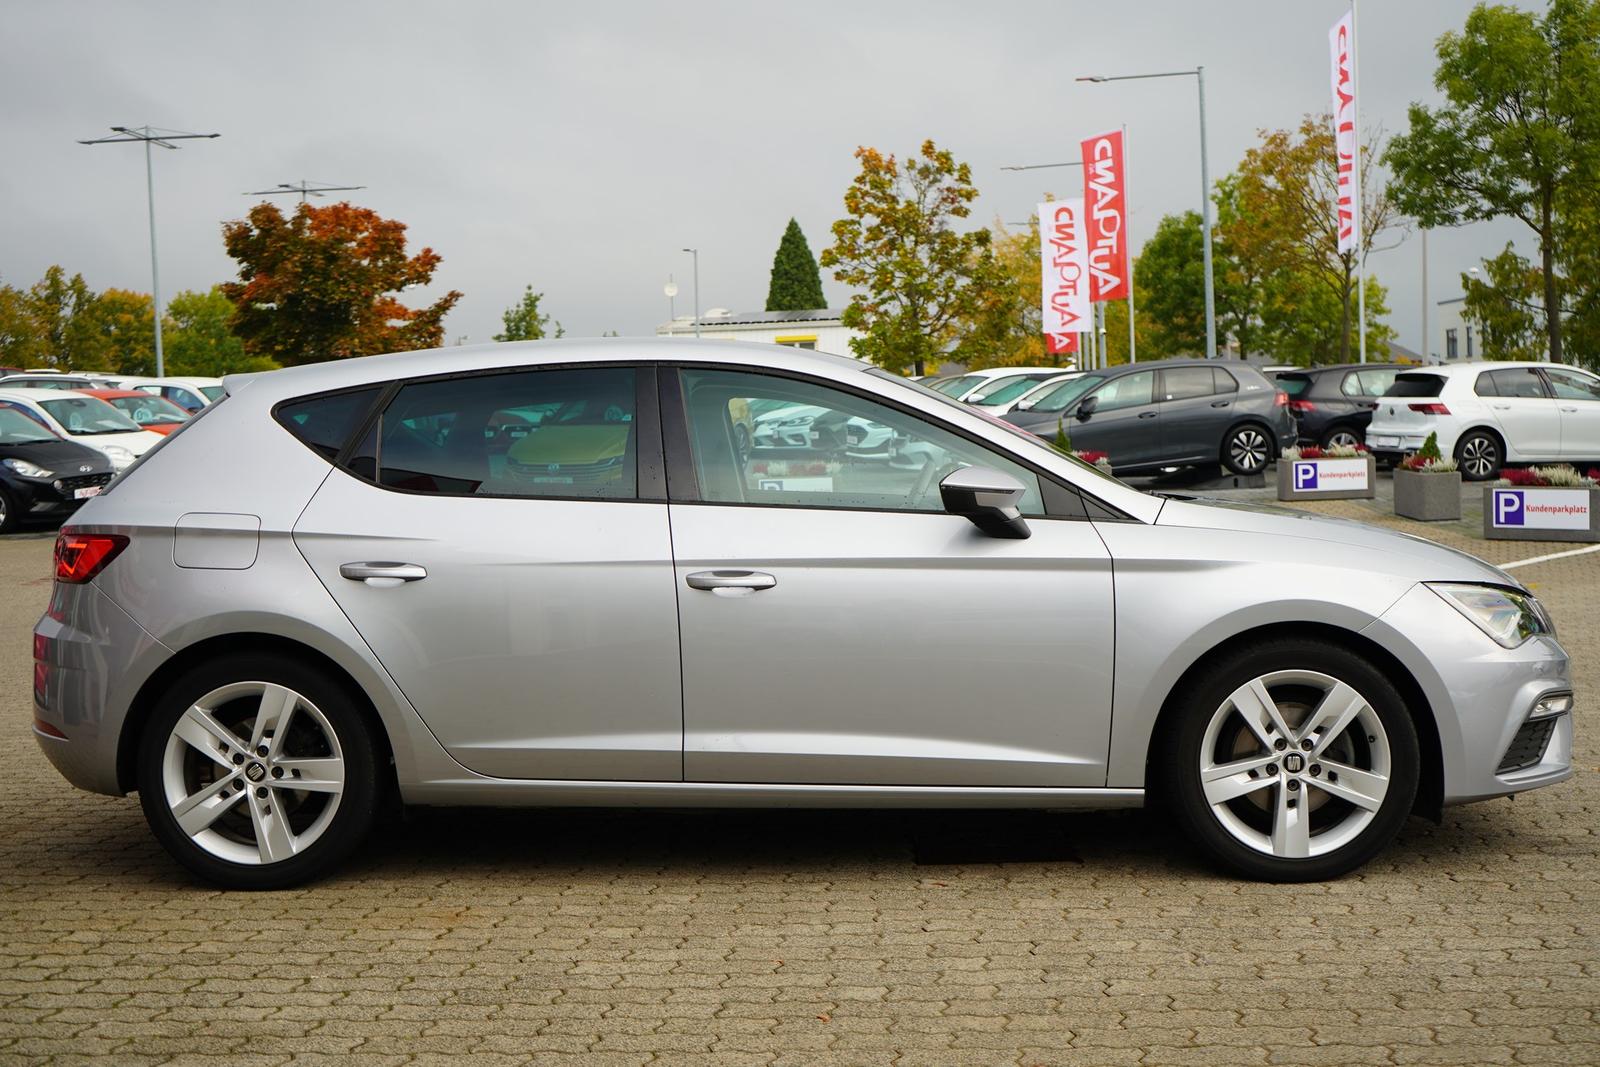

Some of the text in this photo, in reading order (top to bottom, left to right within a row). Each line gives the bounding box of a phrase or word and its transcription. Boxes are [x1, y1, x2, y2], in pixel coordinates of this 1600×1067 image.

[1297, 463, 1366, 489] P Kundenparkplatz
[1499, 493, 1588, 524] P Kundenparkplatz
